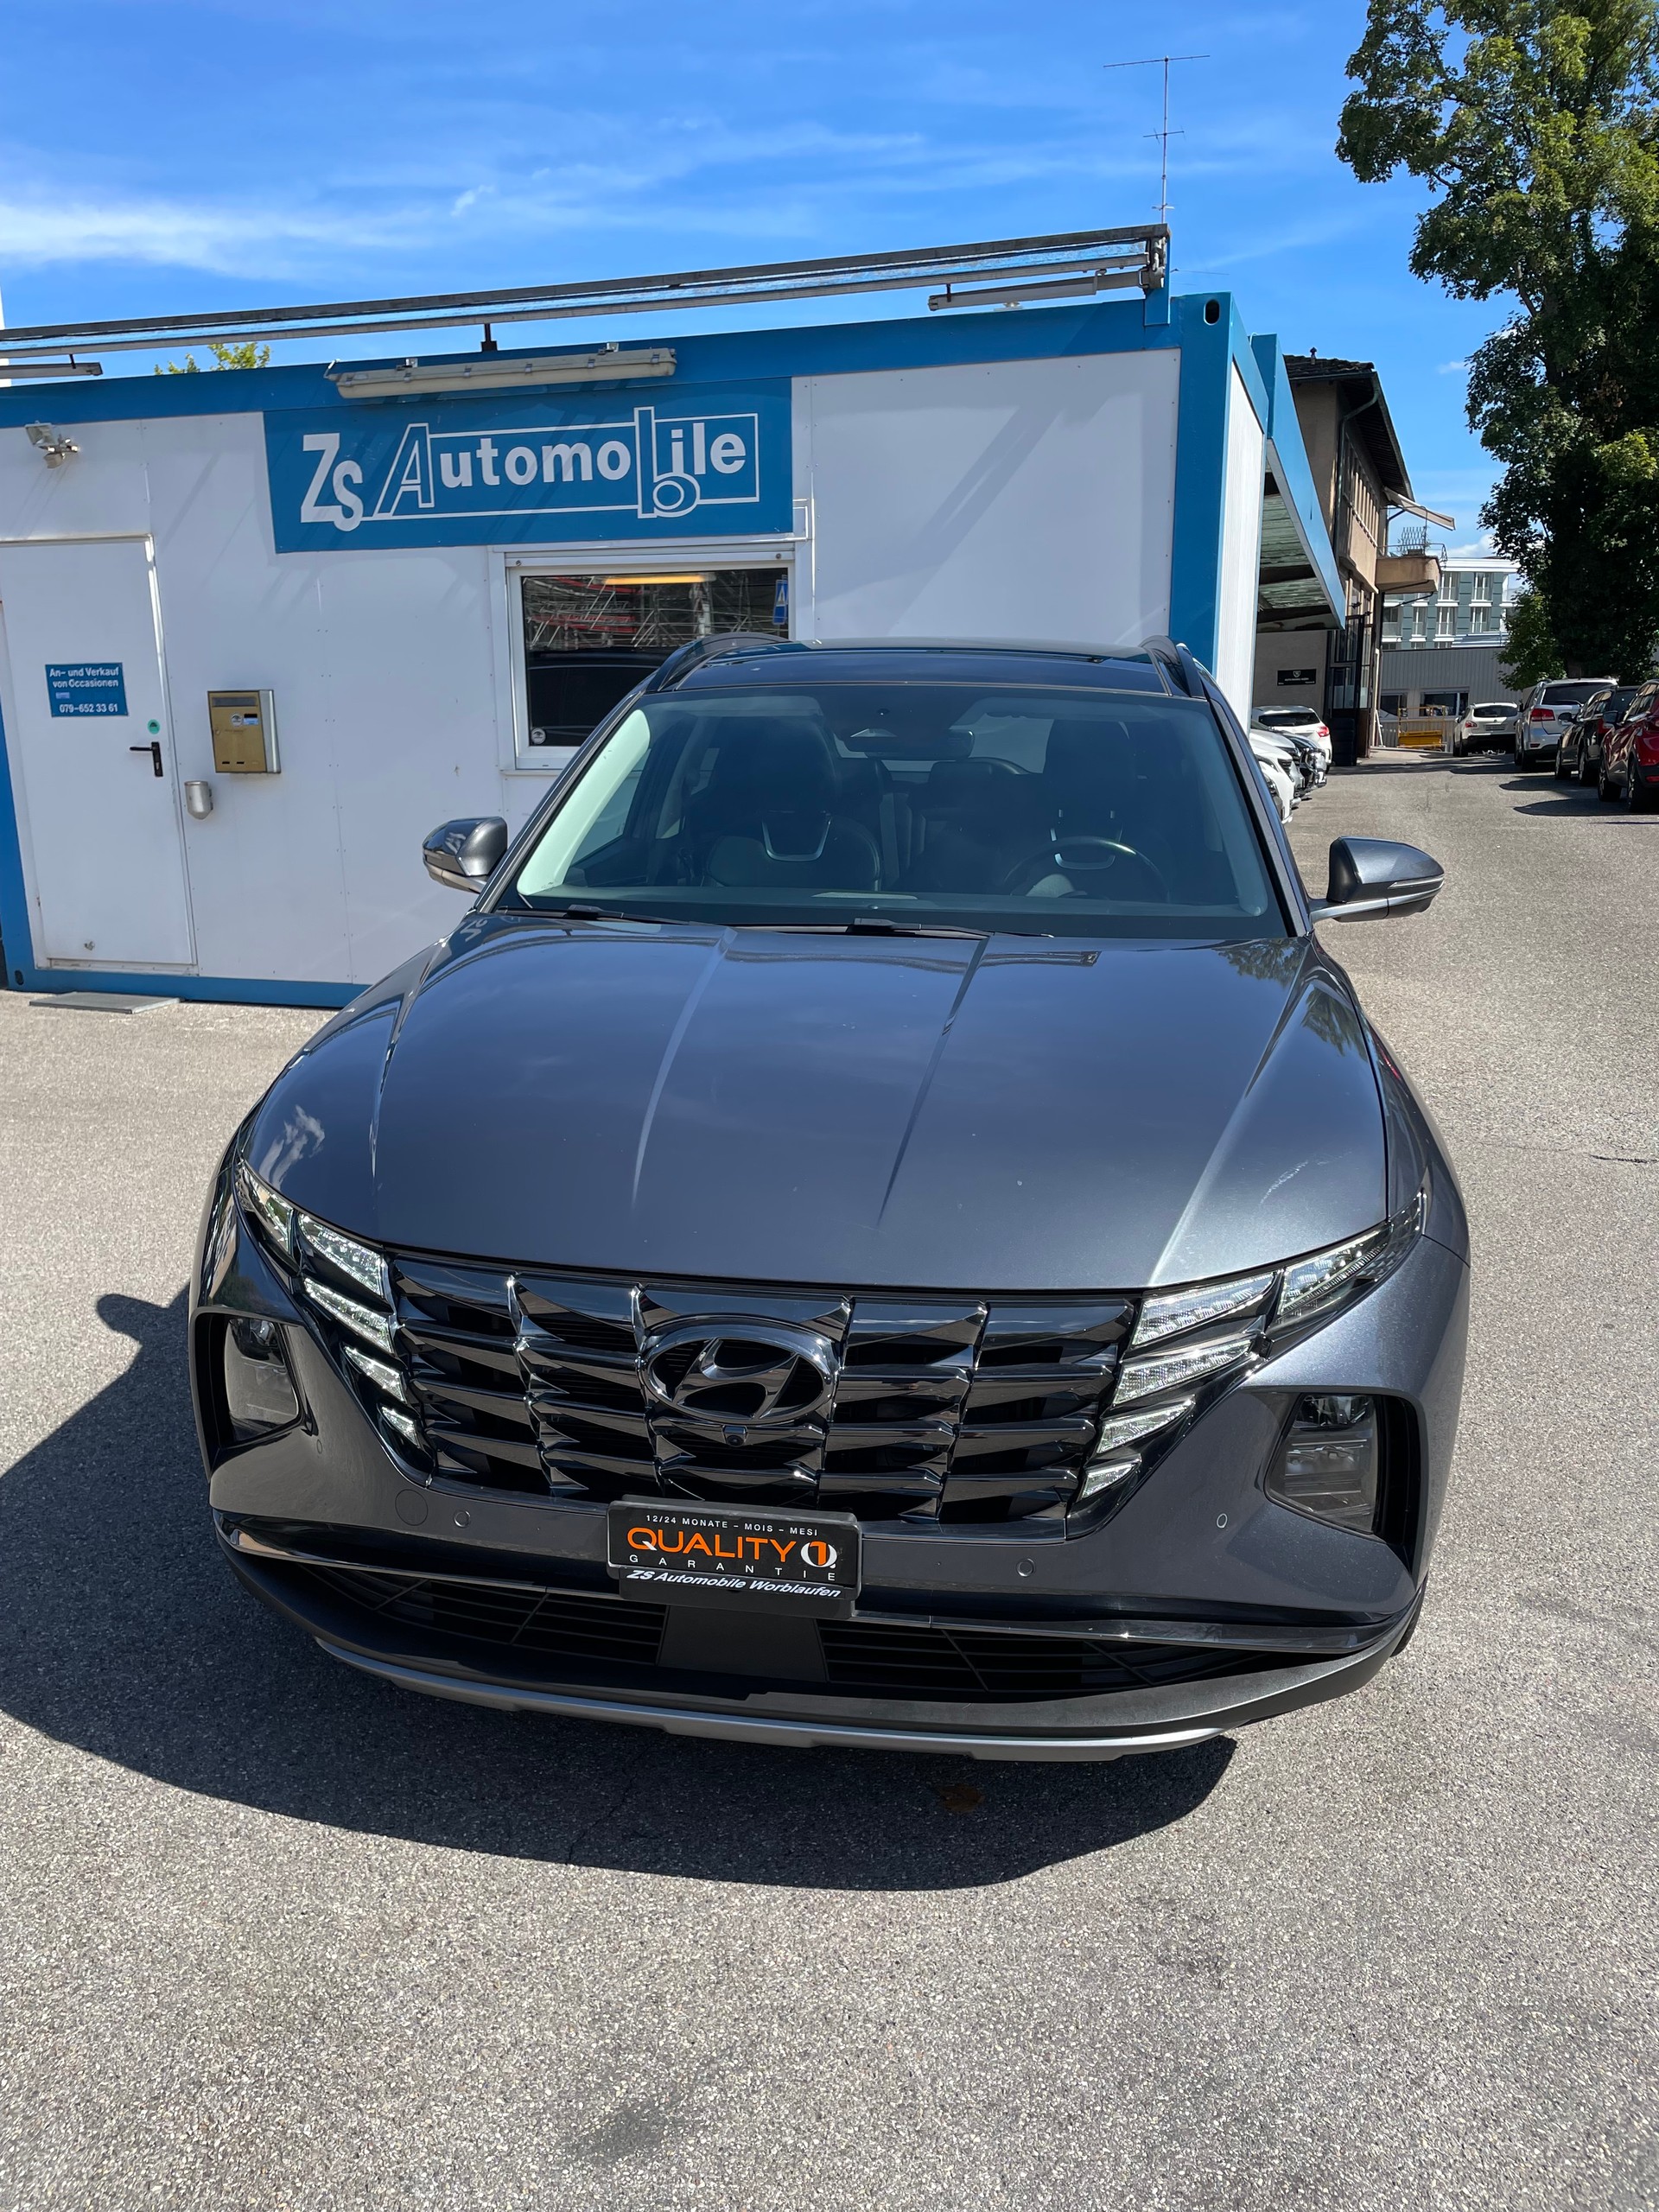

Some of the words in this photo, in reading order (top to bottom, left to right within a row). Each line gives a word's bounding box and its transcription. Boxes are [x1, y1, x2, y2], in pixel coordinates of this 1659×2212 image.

[372, 406, 747, 519] Automobile
[49, 668, 67, 677] An-
[68, 668, 85, 677] und
[85, 666, 119, 677] Verkauf
[68, 678, 119, 688] Occasionen
[59, 703, 94, 713] 079-652
[95, 703, 107, 713] 33
[108, 703, 118, 712] 61
[645, 1515, 677, 1524] 12/24
[682, 1517, 728, 1529] MONATE
[744, 1522, 773, 1533] MOIS
[790, 1527, 818, 1536] MESI
[626, 1527, 797, 1563] QUALITY
[629, 1554, 836, 1581] GARANTIE
[626, 1569, 655, 1580] ZS
[653, 1571, 747, 1589] Automobile
[748, 1580, 842, 1598] Worblaufen
